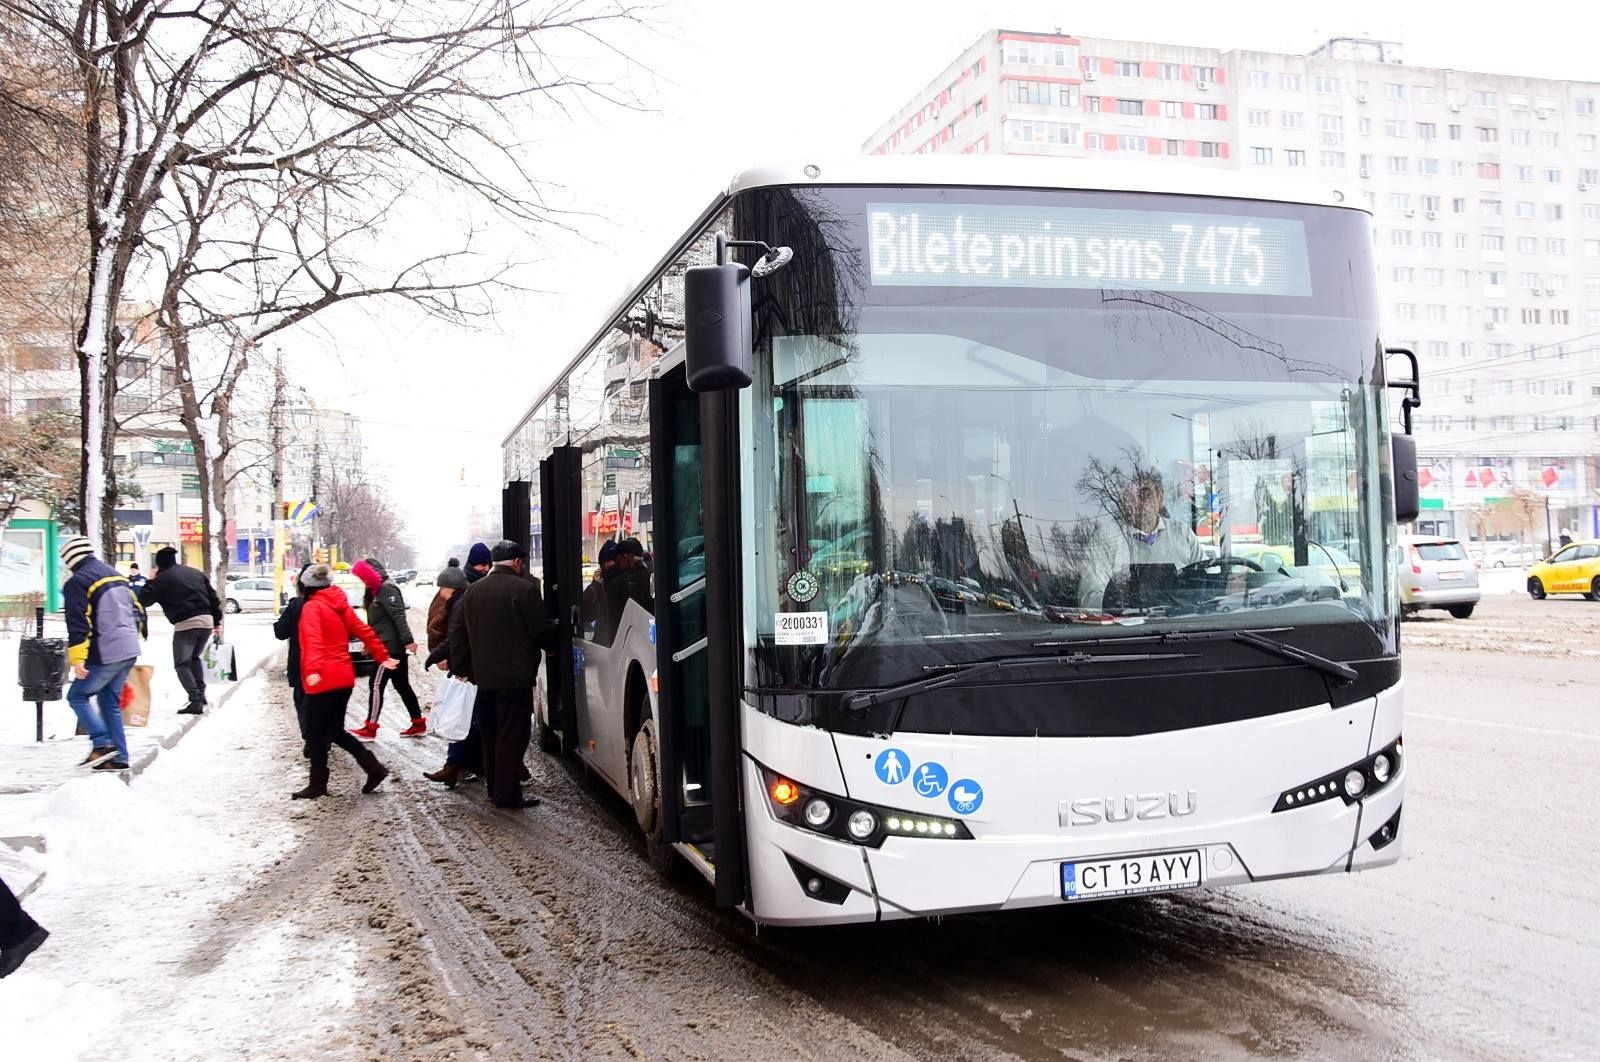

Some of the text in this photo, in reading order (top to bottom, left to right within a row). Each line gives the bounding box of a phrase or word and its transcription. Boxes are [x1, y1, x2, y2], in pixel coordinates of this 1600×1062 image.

[871, 212, 1265, 287] Bilete prin sms 7475
[782, 616, 823, 630] 2000331
[1058, 789, 1198, 828] ISUZU
[1065, 881, 1075, 893] RO
[1082, 865, 1112, 889] CT
[1120, 862, 1142, 886] 13
[1150, 855, 1192, 883] AYY
